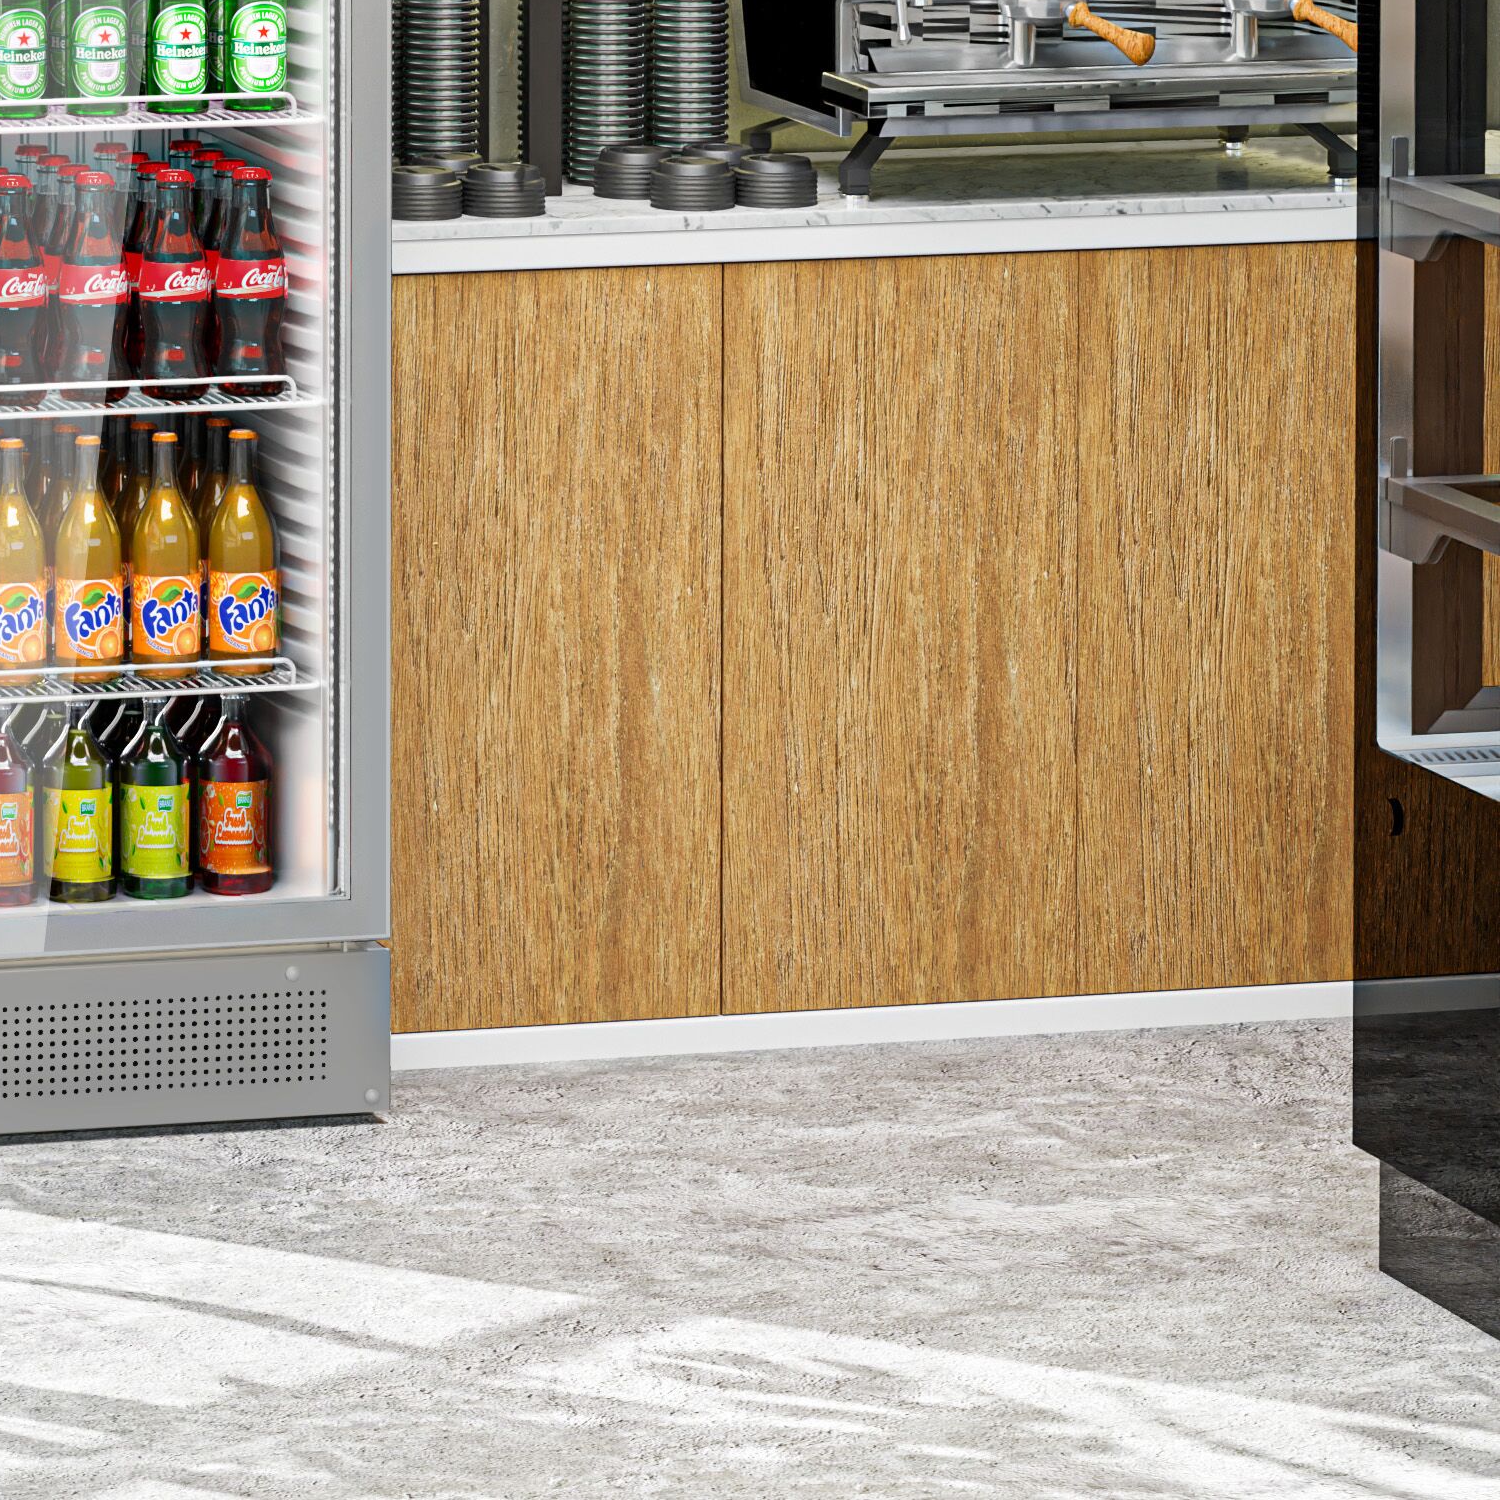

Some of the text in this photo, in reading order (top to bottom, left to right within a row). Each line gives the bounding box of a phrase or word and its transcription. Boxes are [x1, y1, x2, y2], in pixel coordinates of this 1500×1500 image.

[22, 20, 39, 29] LAGER
[102, 16, 120, 26] LAGER
[184, 14, 200, 24] LAGER
[262, 12, 278, 21] LAGER
[234, 42, 286, 56] Heineken
[0, 74, 45, 94] PREMIUM QUALITY
[81, 70, 126, 92] PREMIUM QUALITY
[161, 68, 206, 89] PREMIUM QUALITY
[238, 66, 284, 86] PREMIUM QUALITY
[65, 592, 122, 643] Fanta
[142, 589, 198, 639] Fanta
[219, 586, 275, 636] Fanta
